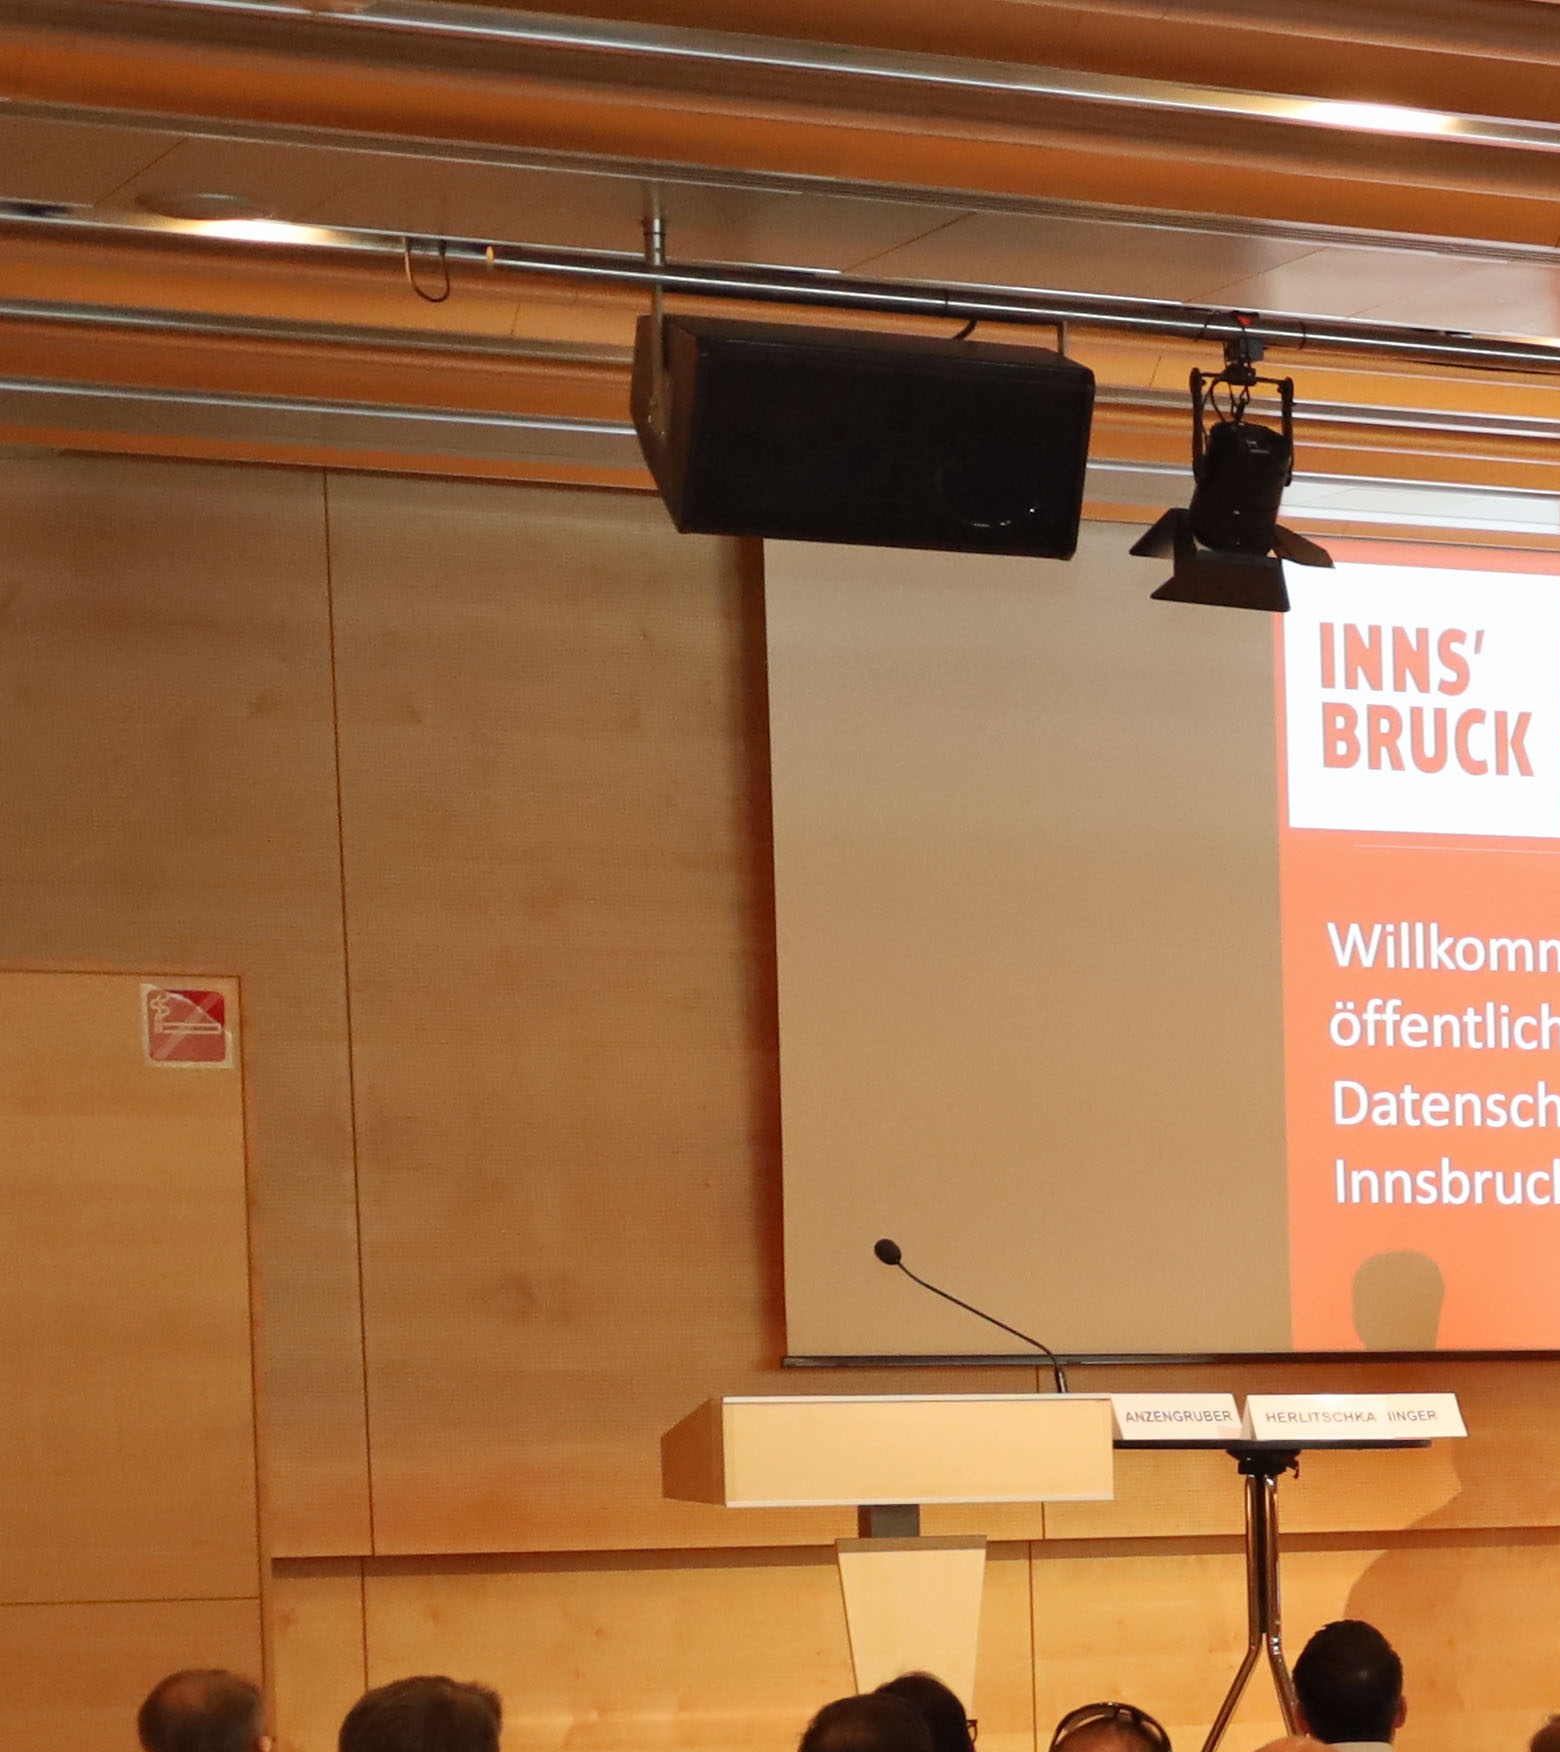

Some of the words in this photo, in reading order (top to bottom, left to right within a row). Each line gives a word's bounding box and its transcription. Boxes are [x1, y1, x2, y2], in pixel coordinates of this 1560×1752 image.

[1319, 622, 1485, 696] INNS'
[1322, 702, 1535, 777] BRUCK
[1125, 1410, 1234, 1423] ANZENGRUBER
[1265, 1410, 1377, 1424] HERLITSCHKA
